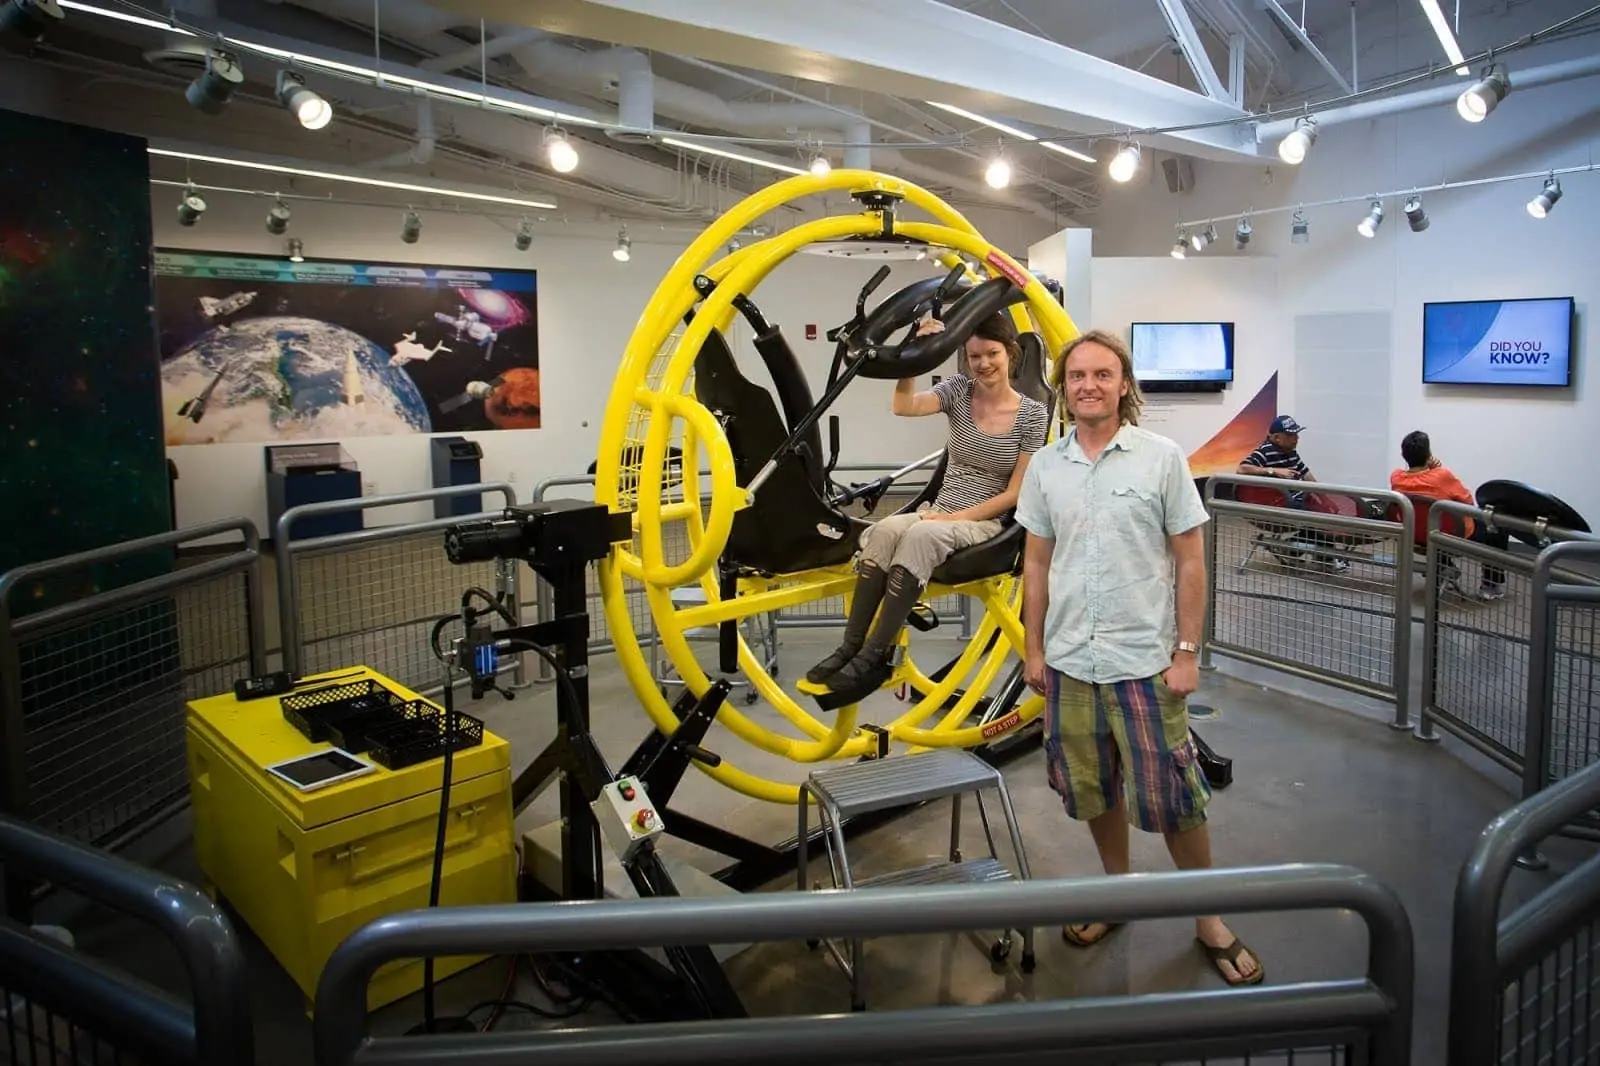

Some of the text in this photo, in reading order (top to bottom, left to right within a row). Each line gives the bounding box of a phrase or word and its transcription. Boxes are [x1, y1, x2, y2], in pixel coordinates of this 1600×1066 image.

[1490, 341, 1542, 351] DID YOU
[1490, 352, 1550, 364] KNOW?
[1003, 716, 1018, 729] STEP
